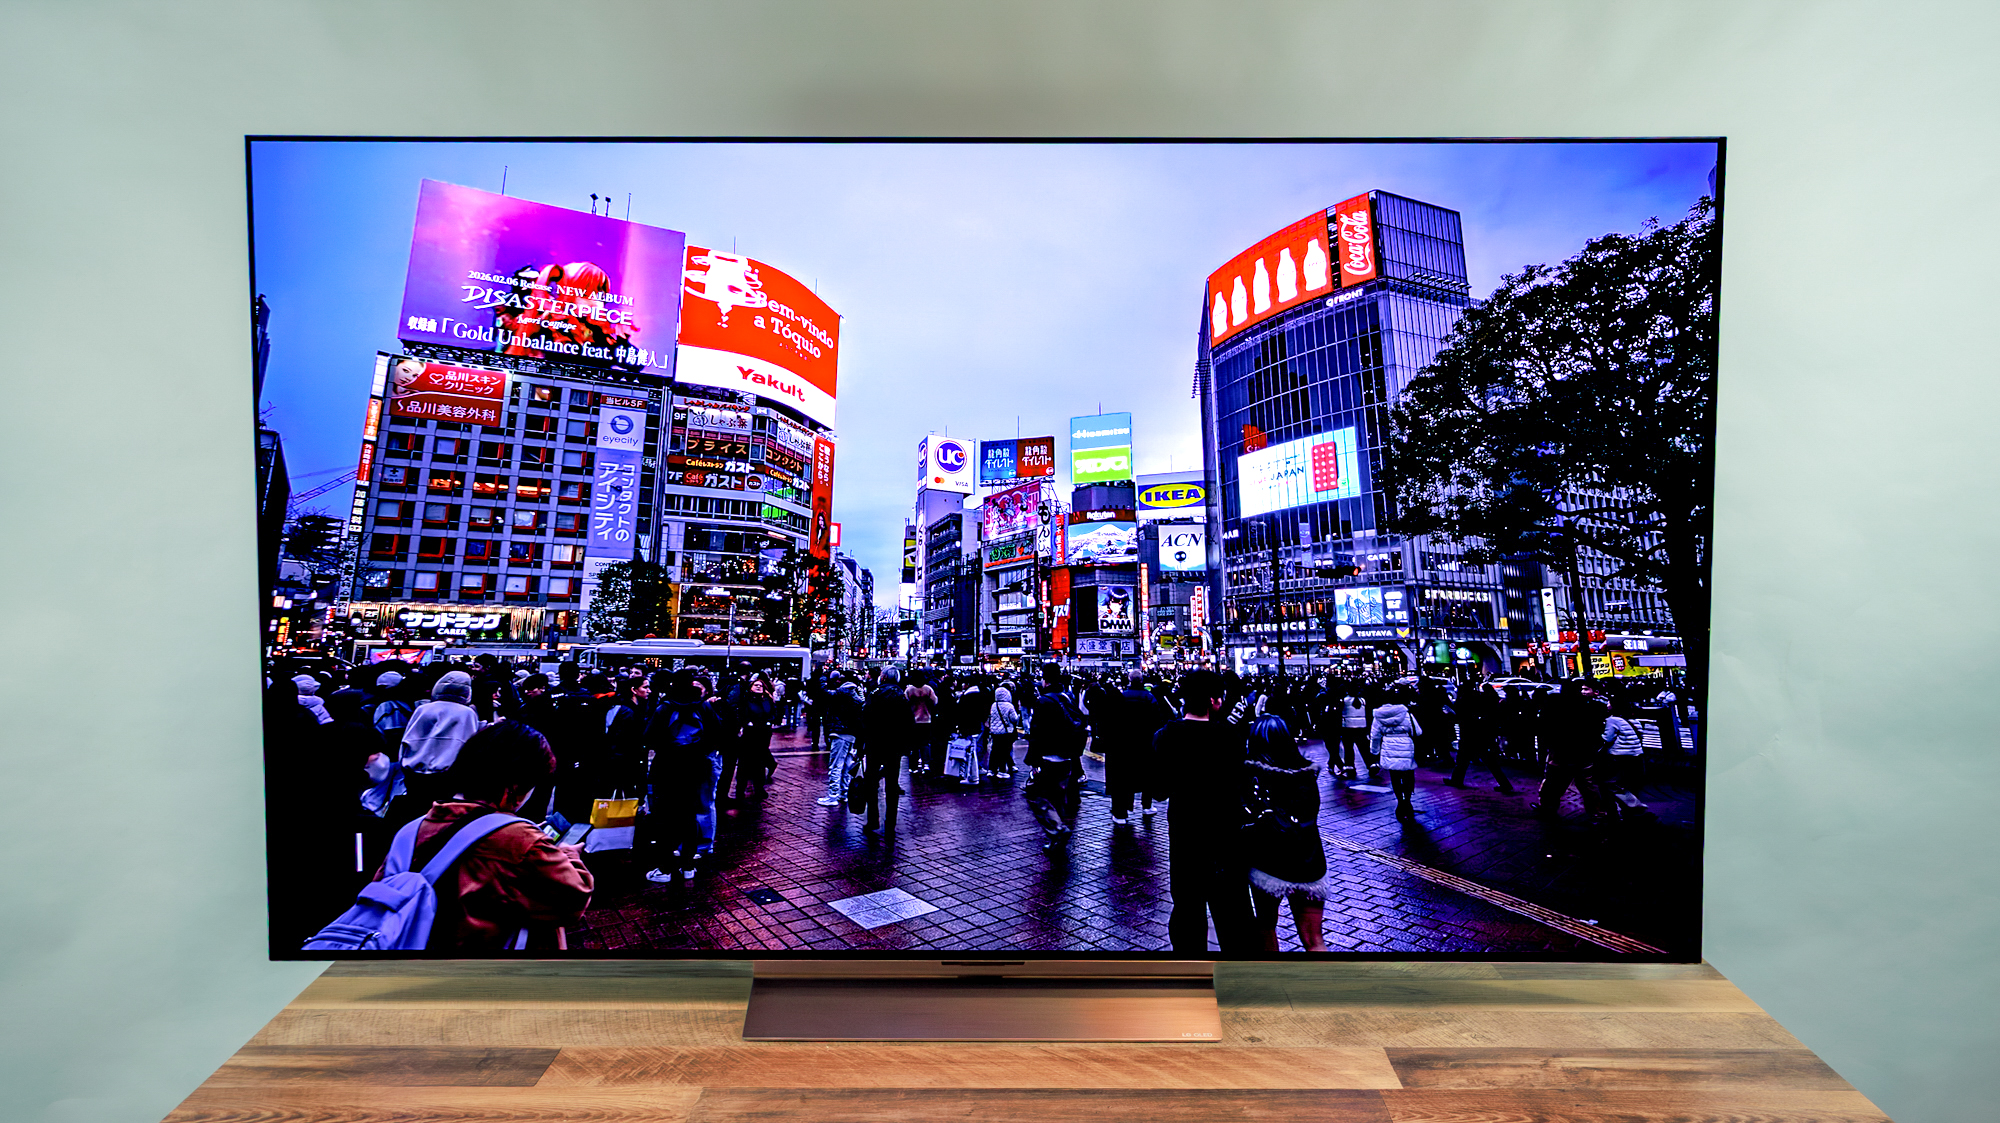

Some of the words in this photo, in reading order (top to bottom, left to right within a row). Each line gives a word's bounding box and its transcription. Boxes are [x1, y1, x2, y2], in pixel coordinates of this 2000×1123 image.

[468, 270, 519, 287] 2026.02.06
[520, 279, 553, 292] Release
[556, 284, 587, 298] NEW
[588, 291, 634, 306] ALBUM
[461, 285, 634, 326] DISASTERPIECE
[517, 315, 540, 325] Mori
[498, 328, 579, 355] Unbalance
[581, 341, 613, 360] feat.
[754, 315, 766, 329] a
[771, 317, 821, 358] Tóquio
[445, 371, 501, 385] 品川スキン
[737, 366, 805, 402] Yakult
[444, 381, 494, 395] クリニック
[406, 400, 496, 421] 品川美容外科
[673, 412, 686, 421] 9F
[603, 435, 638, 446] eyecity
[687, 438, 747, 454] プライス
[766, 448, 803, 471] コンタクト
[668, 471, 684, 480] 7F
[704, 473, 742, 488] ガスト
[594, 462, 620, 540] アイシティ
[615, 464, 635, 541] コンタクトの
[1145, 488, 1201, 502] IKEA
[1161, 533, 1203, 547] ACN
[399, 612, 502, 630] サンドラッグ
